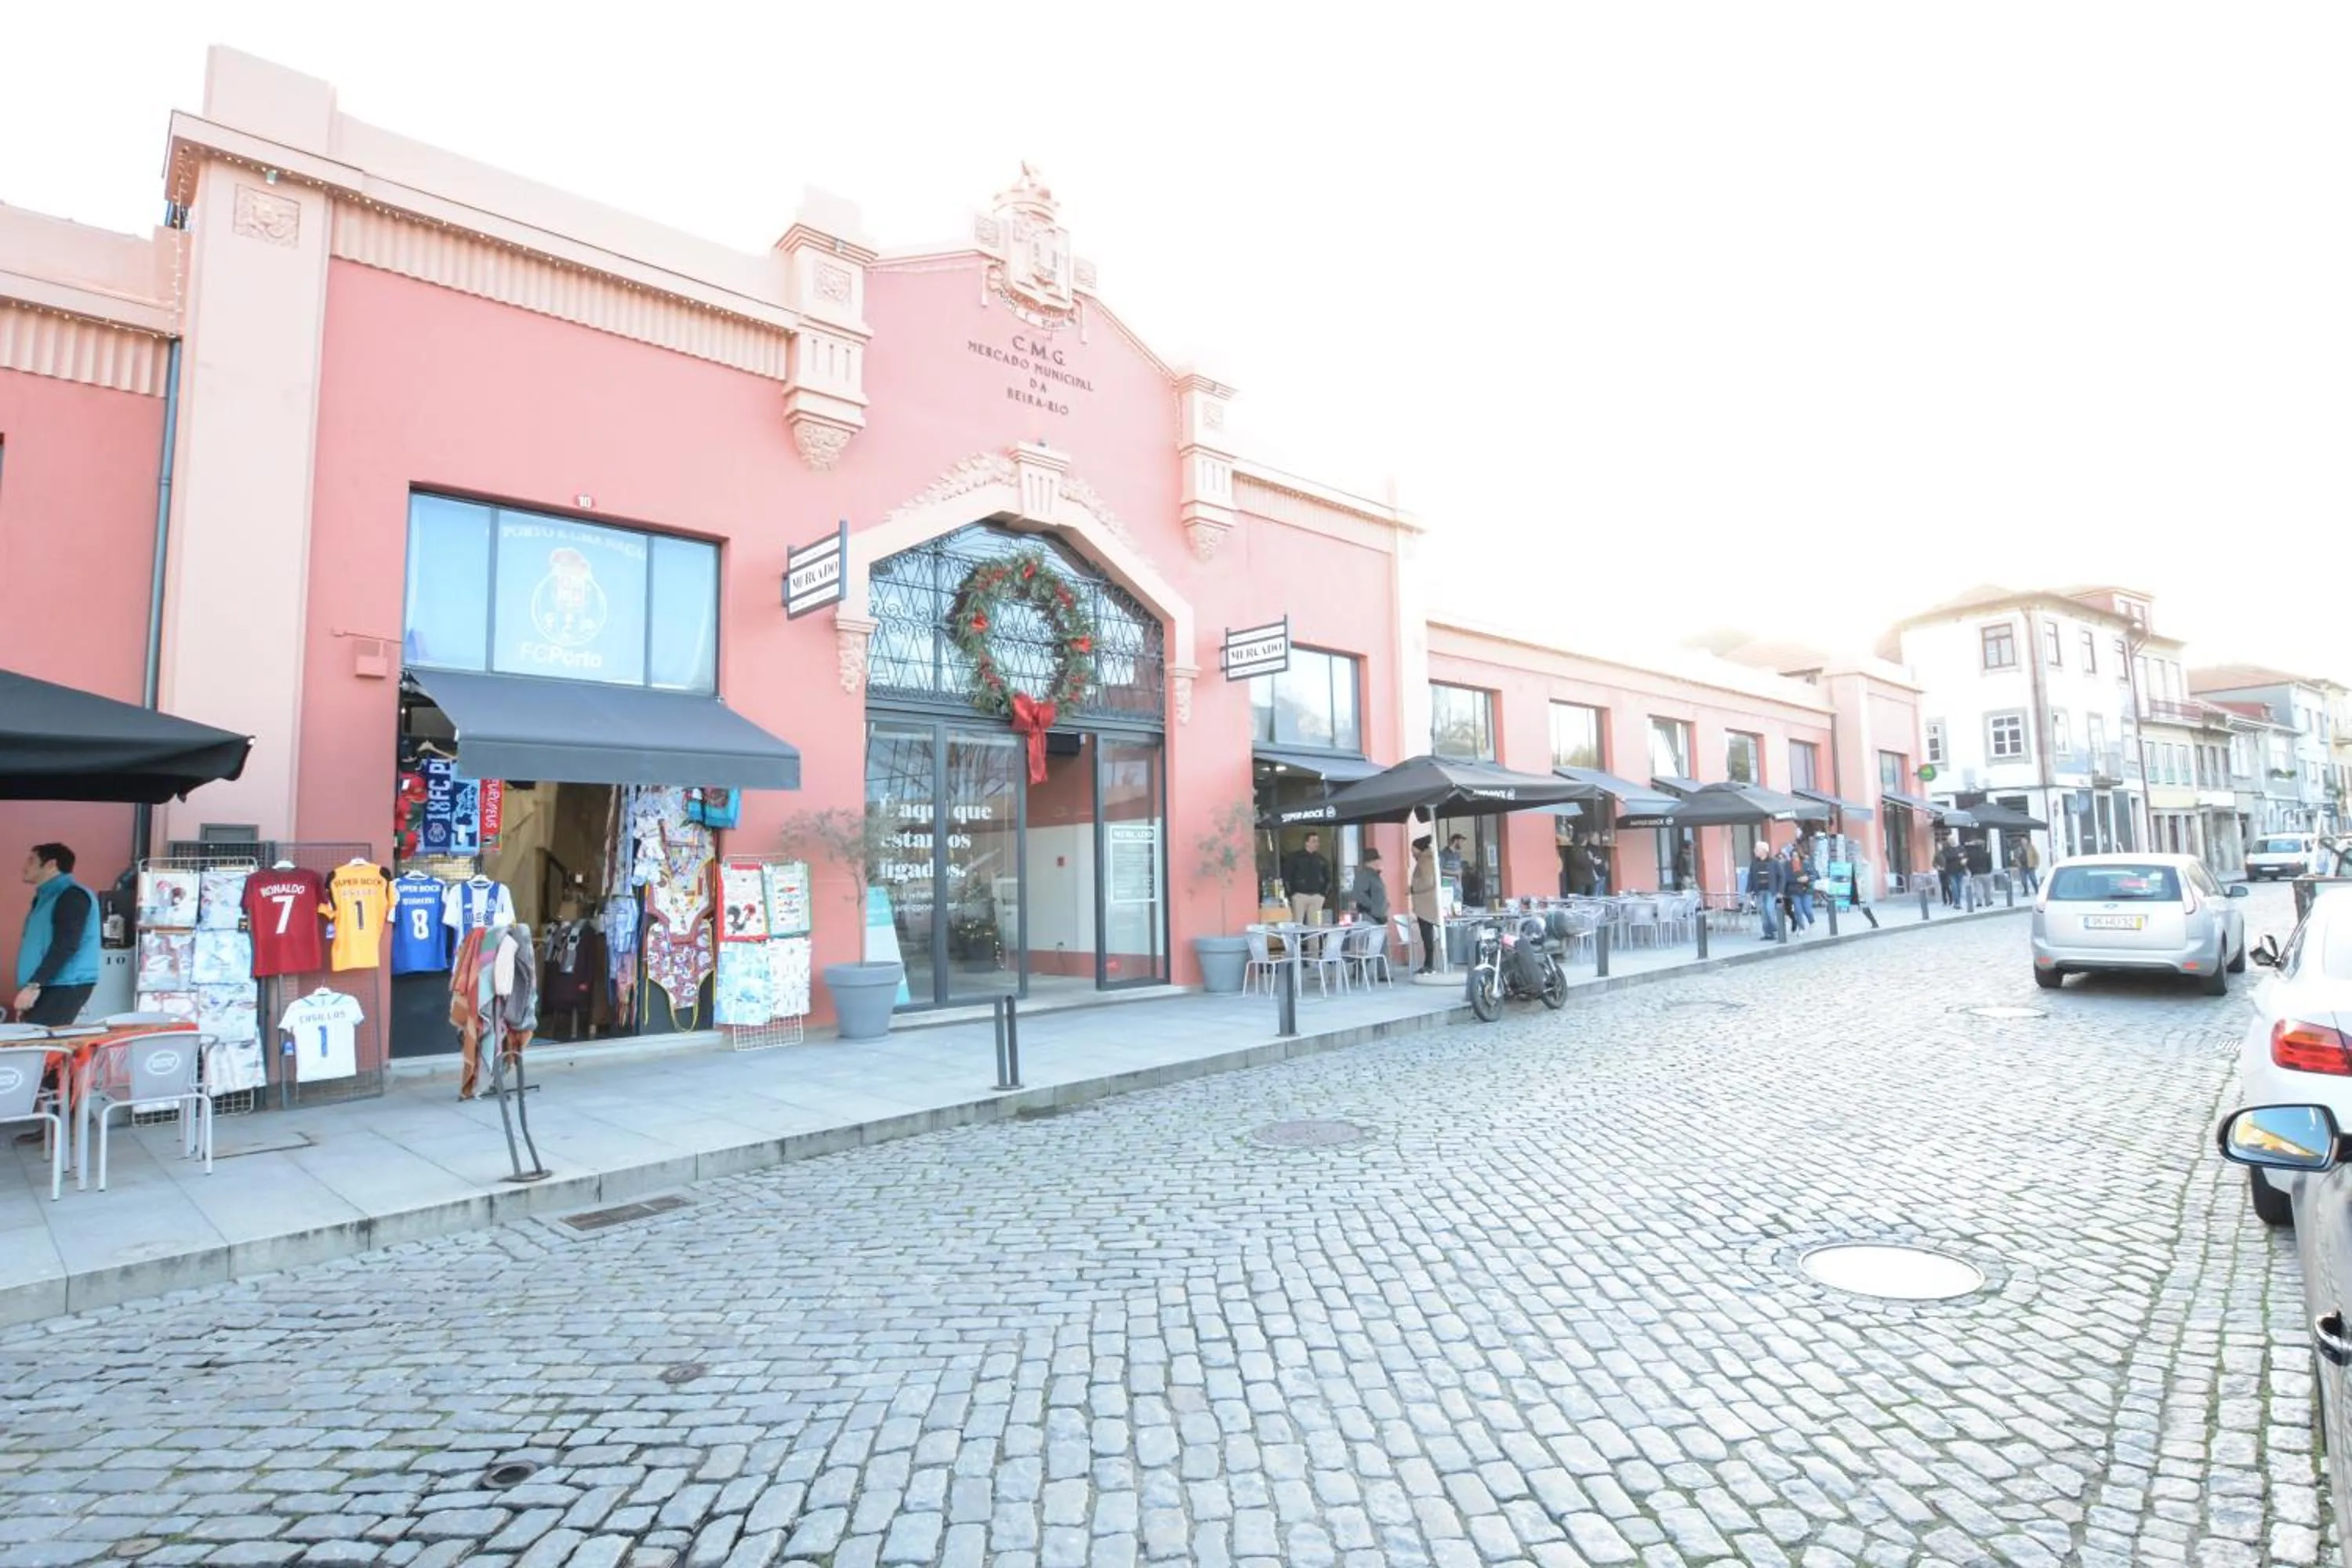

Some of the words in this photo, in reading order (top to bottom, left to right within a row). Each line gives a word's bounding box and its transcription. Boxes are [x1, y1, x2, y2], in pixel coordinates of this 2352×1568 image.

[968, 340, 1029, 368] MERCADO
[1034, 363, 1094, 391] MUNICIPAL
[1029, 378, 1047, 393] DA
[793, 561, 838, 590] MERCADO
[1231, 643, 1282, 660] MERCADO
[953, 805, 993, 824] que
[879, 858, 967, 884] ligads.
[260, 884, 305, 897] RONALDO
[272, 895, 295, 934] 7
[354, 900, 364, 930] 1
[412, 909, 429, 940] 8
[318, 1025, 328, 1058] 1
